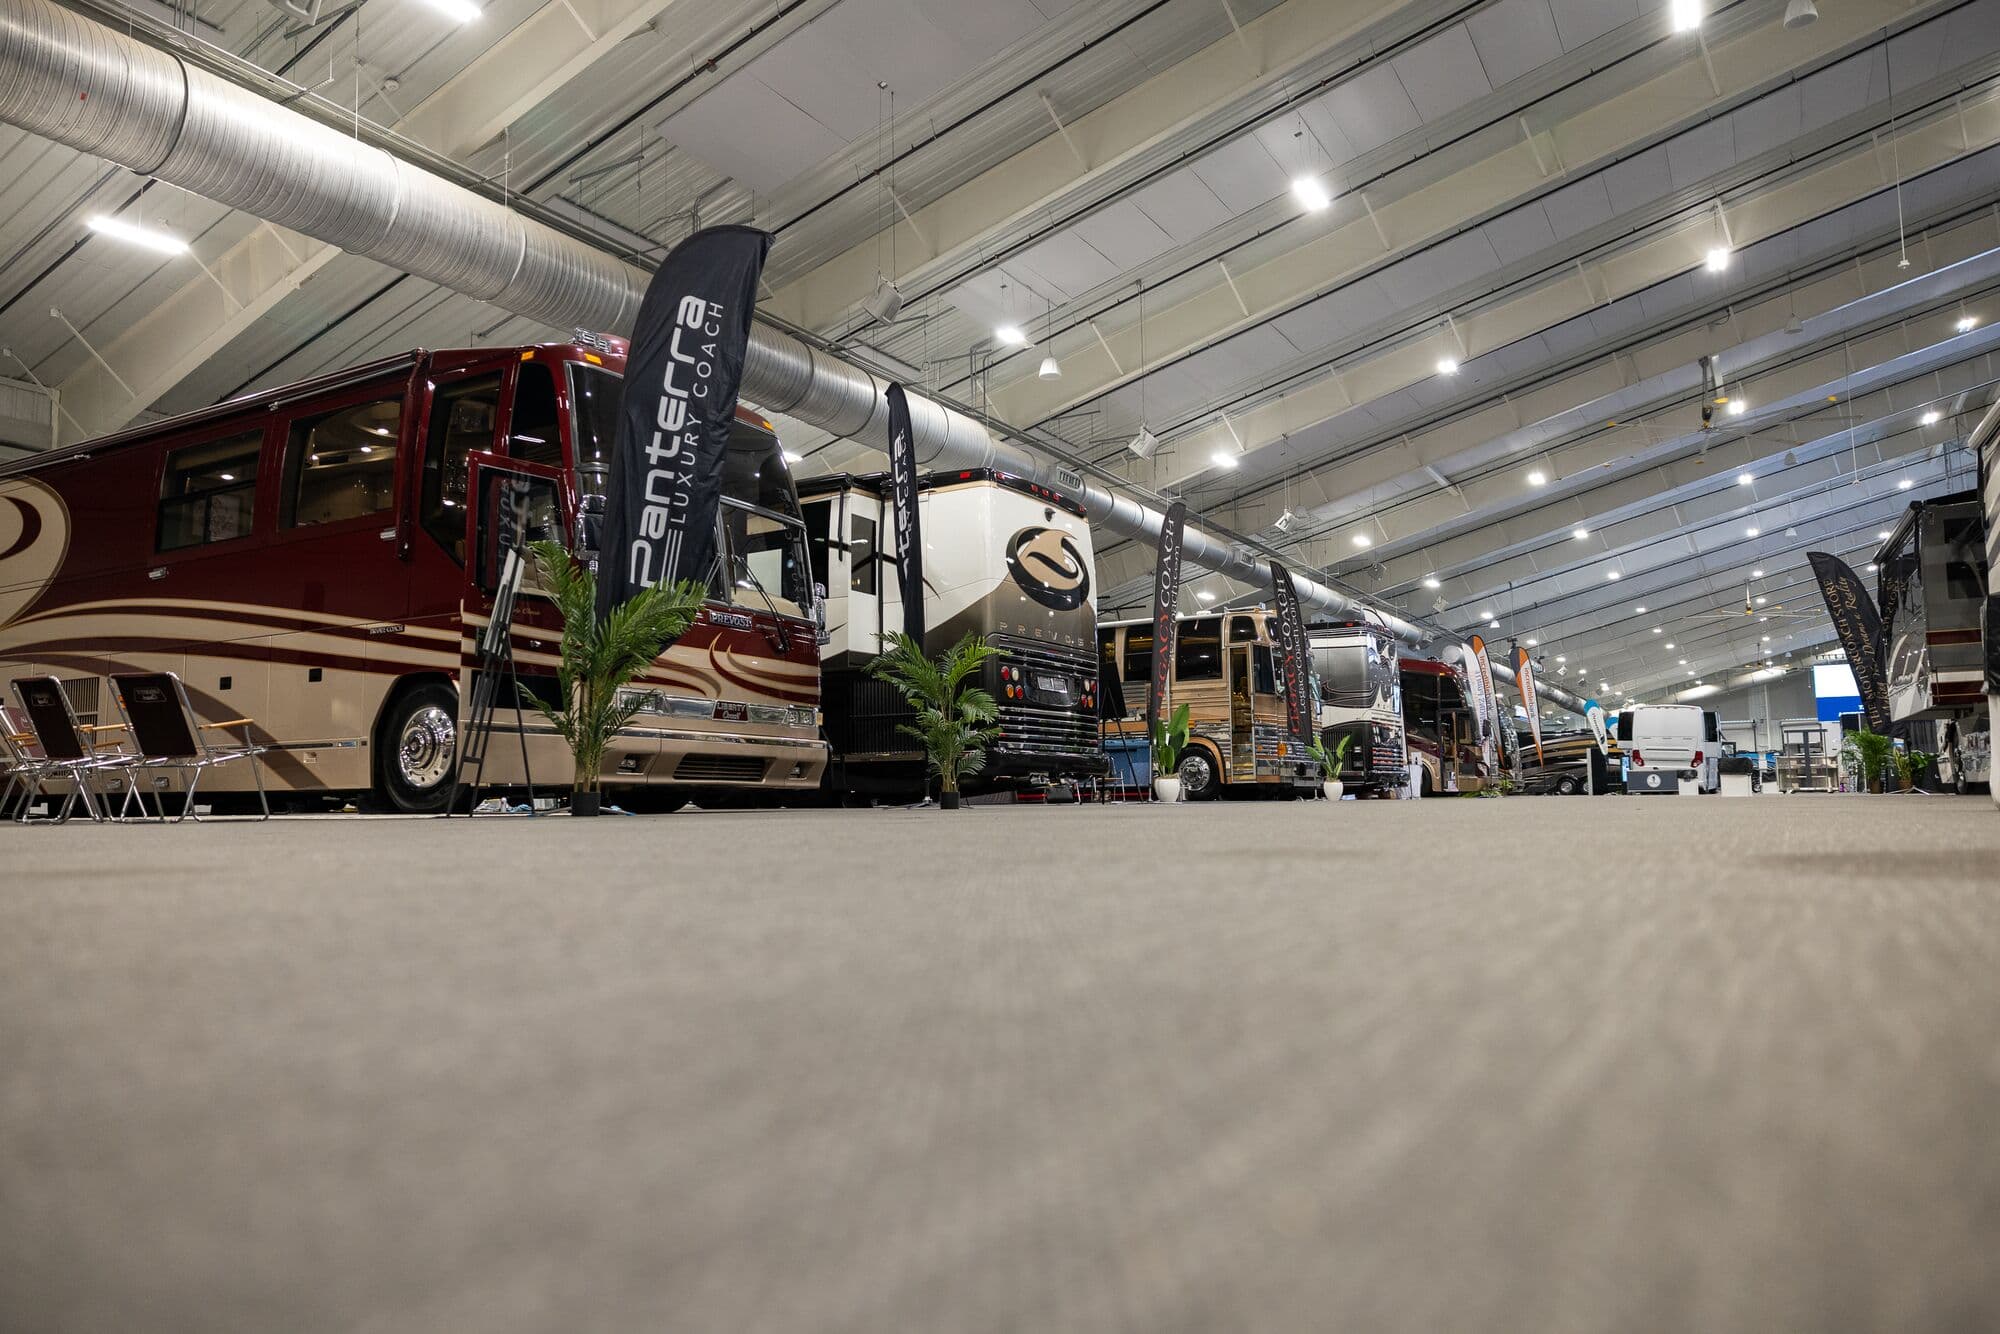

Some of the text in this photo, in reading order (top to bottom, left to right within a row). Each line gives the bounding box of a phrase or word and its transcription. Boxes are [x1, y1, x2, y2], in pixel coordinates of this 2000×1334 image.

[630, 295, 707, 589] Panterra
[670, 302, 724, 524] LUXURY COACH
[711, 612, 752, 627] PREVOST
[1000, 621, 1096, 648] PREVOST
[1838, 576, 1857, 610] Reality
[1823, 579, 1883, 727] THE MOTORCOACH STORE
